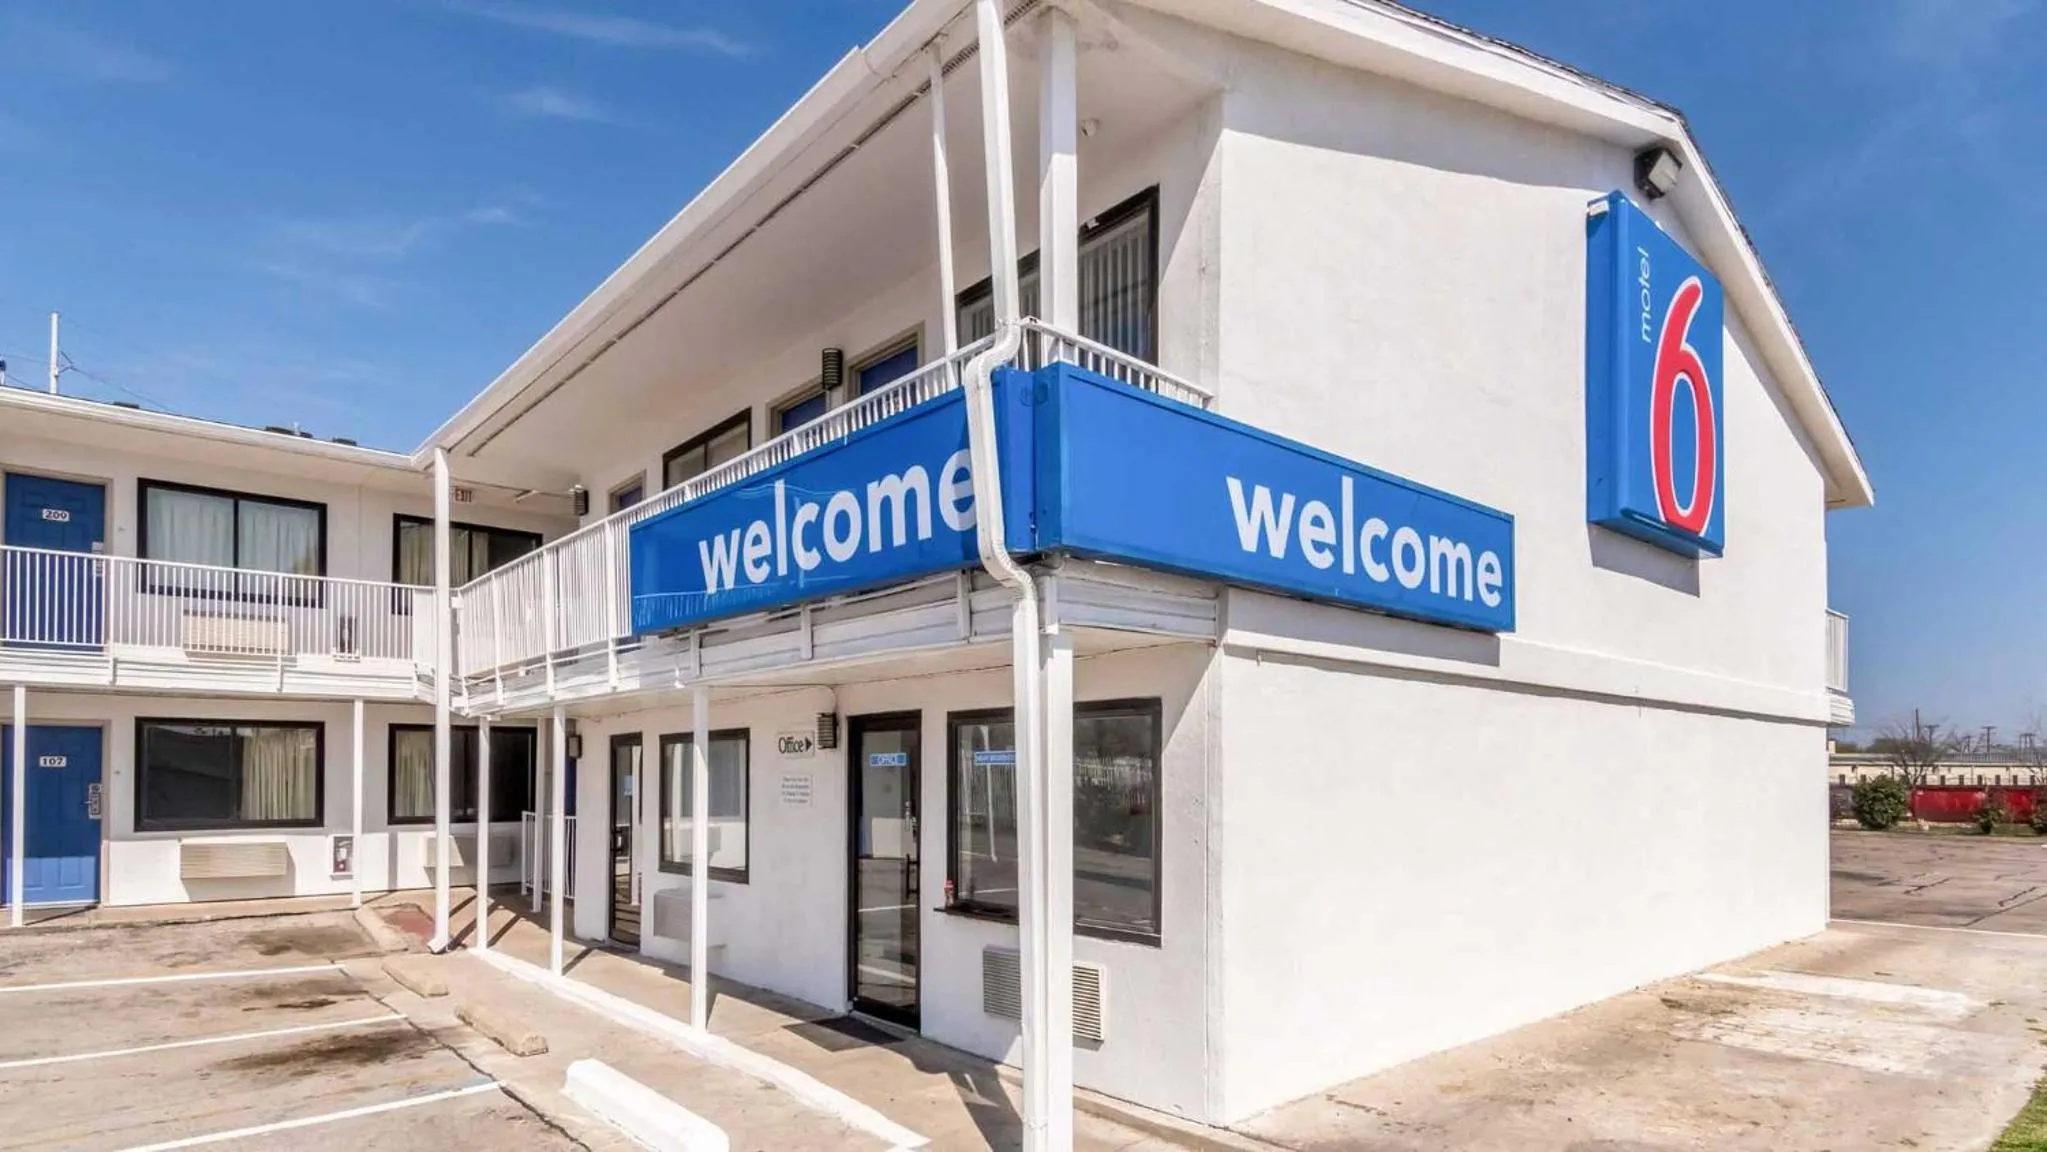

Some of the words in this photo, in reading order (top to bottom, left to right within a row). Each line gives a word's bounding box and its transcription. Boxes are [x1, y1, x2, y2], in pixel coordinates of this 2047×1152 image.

[1637, 245, 1652, 344] motel
[1649, 275, 1717, 538] 6
[698, 448, 977, 595] welcome
[1225, 475, 1503, 608] welcome
[43, 757, 63, 765] 107
[778, 736, 804, 754] Office
